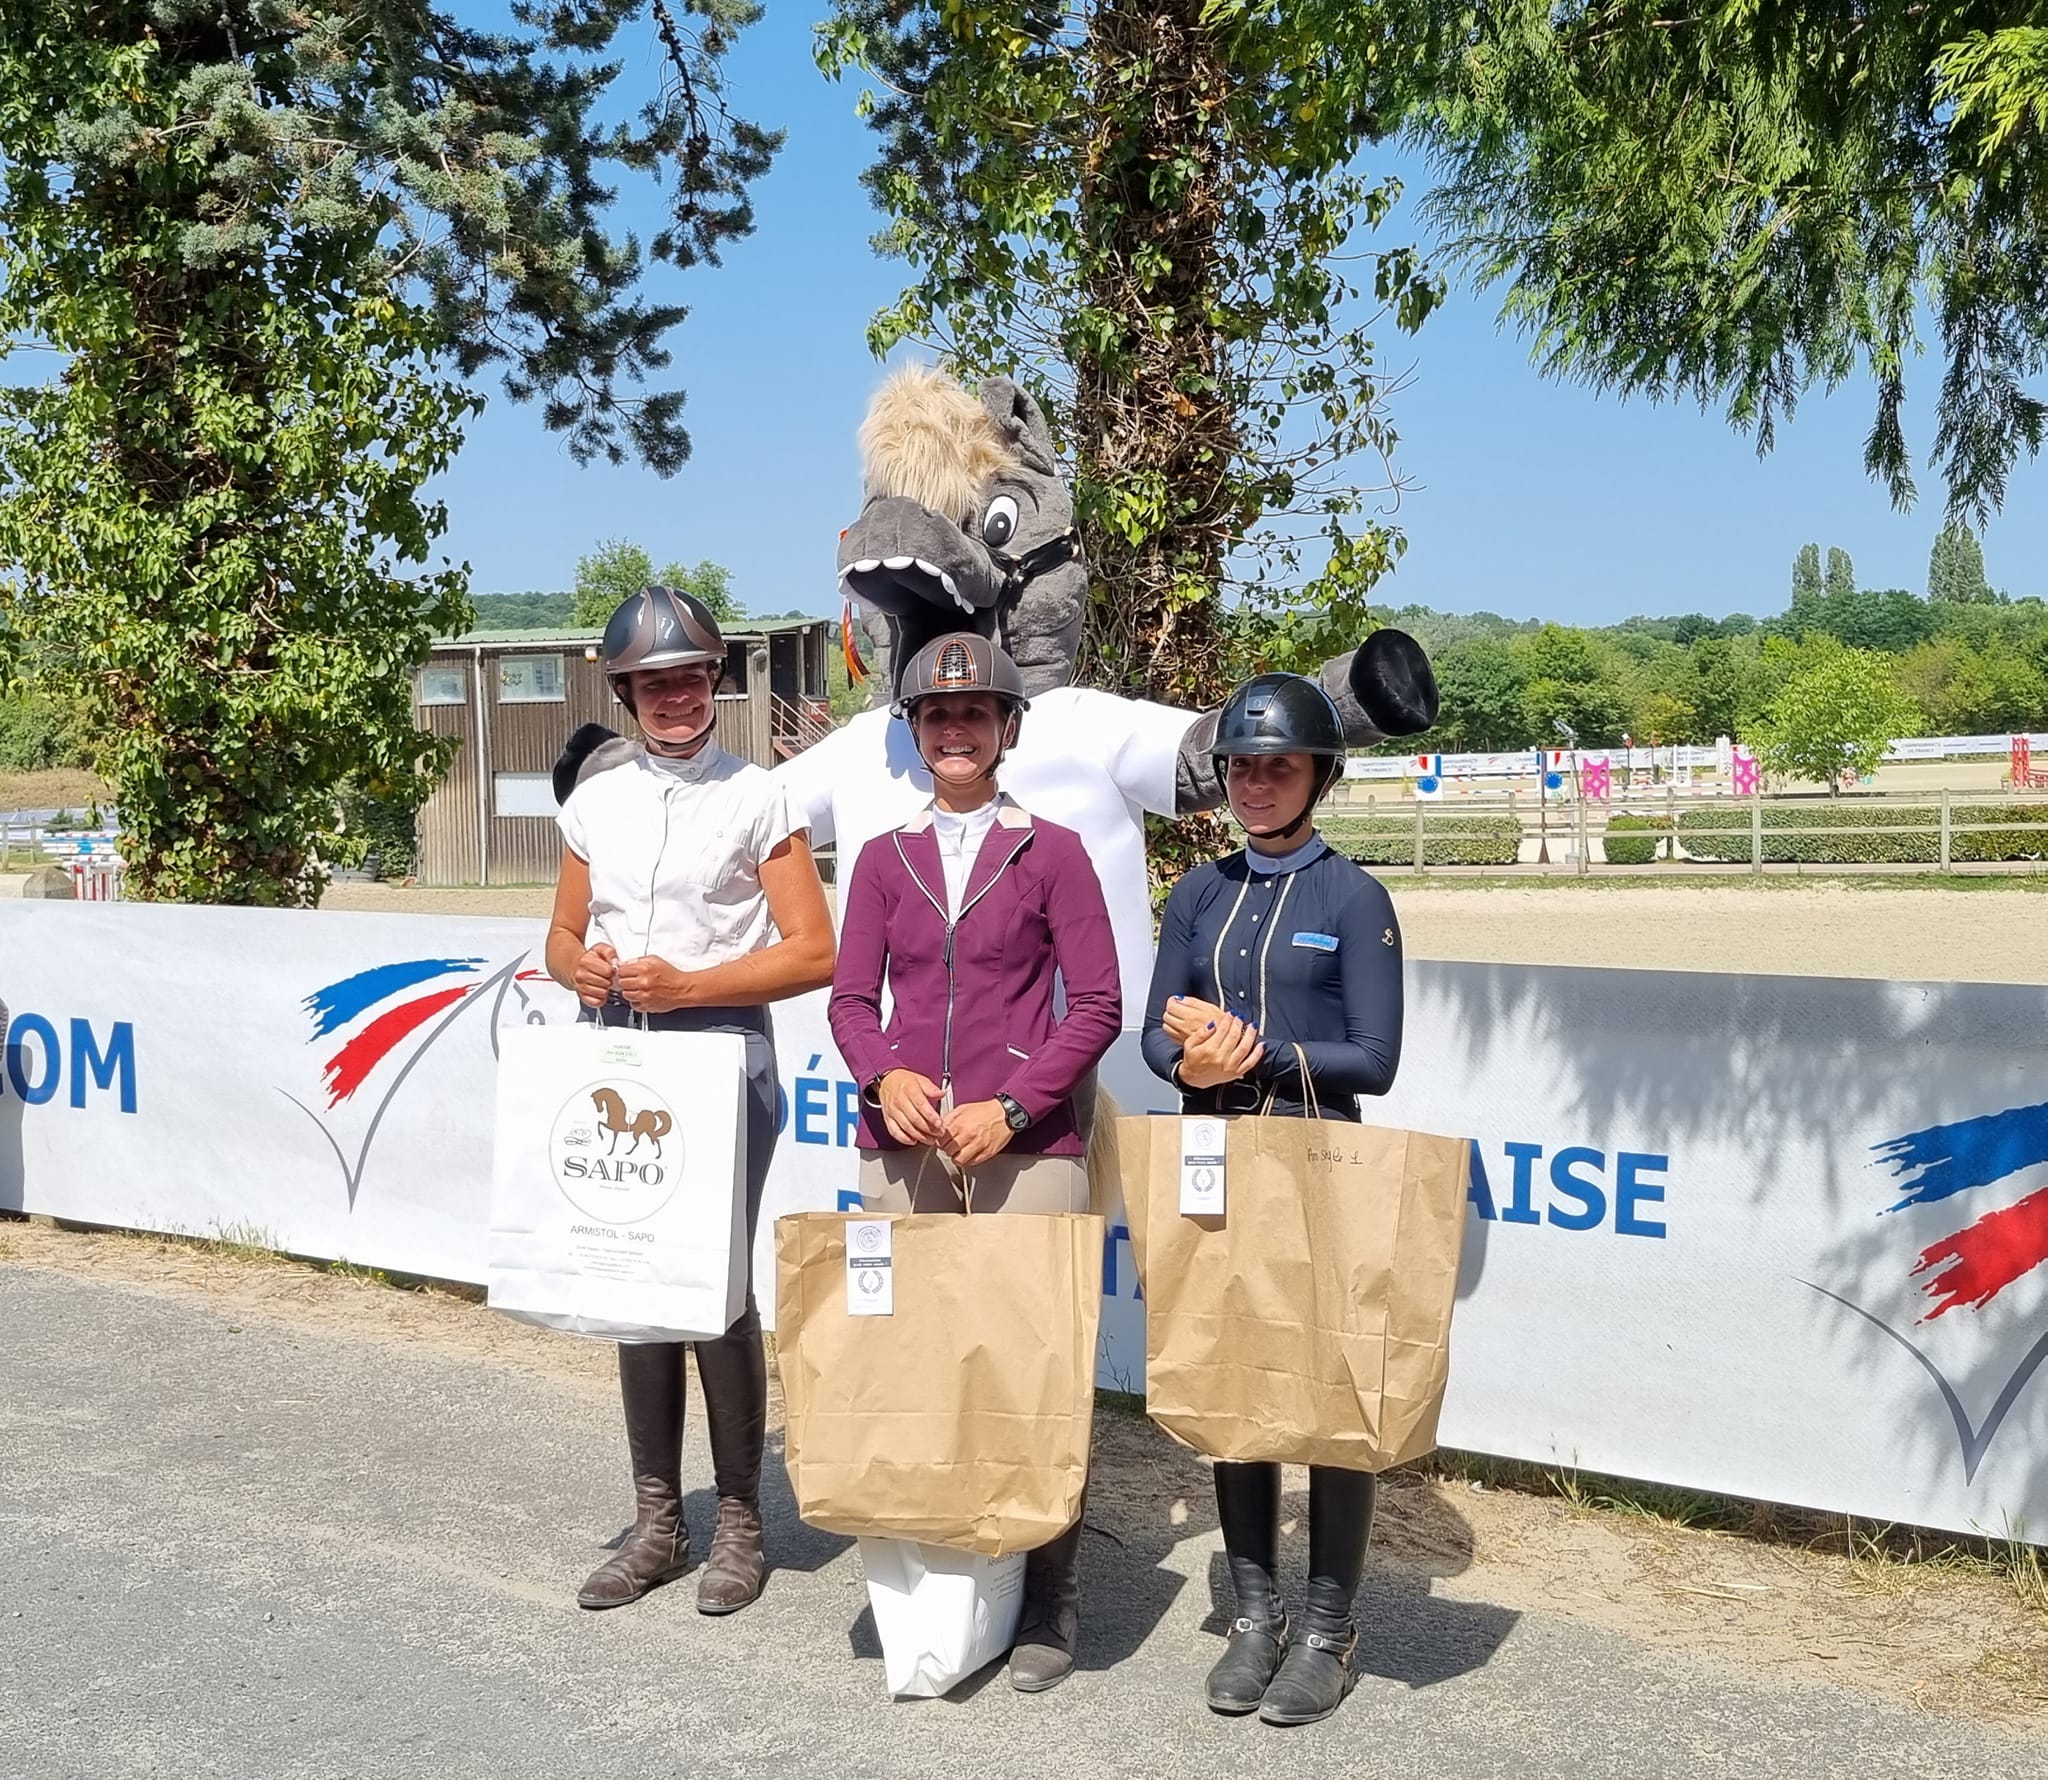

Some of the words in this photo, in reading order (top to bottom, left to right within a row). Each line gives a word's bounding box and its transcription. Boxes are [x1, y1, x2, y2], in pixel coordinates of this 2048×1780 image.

[563, 1156, 664, 1185] SAPO
[570, 1225, 620, 1239] ARMISTOL
[628, 1231, 655, 1243] SAPO
